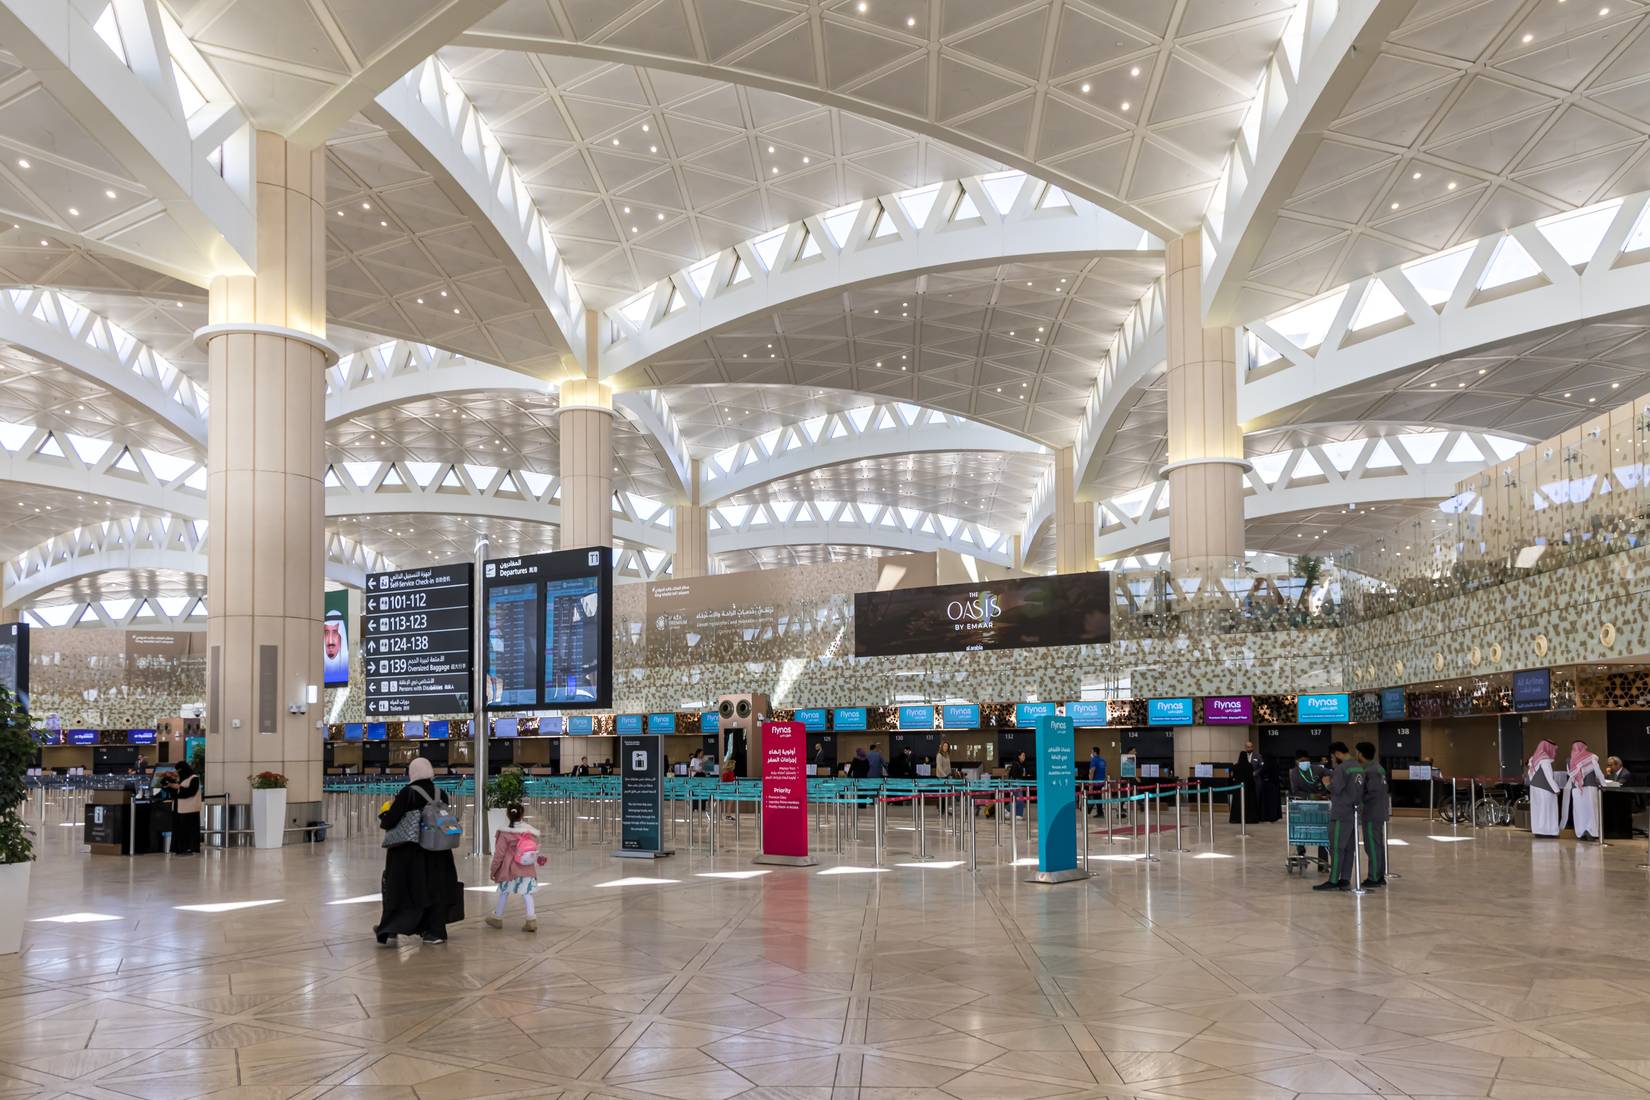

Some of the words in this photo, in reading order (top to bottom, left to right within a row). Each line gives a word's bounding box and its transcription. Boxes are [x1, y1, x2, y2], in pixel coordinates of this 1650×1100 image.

[590, 553, 599, 564] T1
[500, 568, 528, 577] Departures
[390, 580, 414, 588] Self-Service
[416, 577, 434, 585] Check-in
[390, 593, 426, 610] 101-112
[947, 598, 1002, 620] OASIS
[390, 614, 427, 630] 113-123
[390, 636, 428, 651] 124-138
[390, 659, 407, 672] 139
[430, 664, 449, 672] Baggage
[1157, 702, 1183, 711] flynas
[1214, 700, 1241, 710] flynas
[1308, 698, 1338, 708] flynas
[950, 708, 971, 716] flynas
[1024, 705, 1047, 714] flynas
[1074, 704, 1097, 713] flynas
[653, 715, 669, 724] flynas
[706, 714, 719, 722] flyn
[1051, 721, 1066, 730] flynas
[772, 726, 792, 735] flynas
